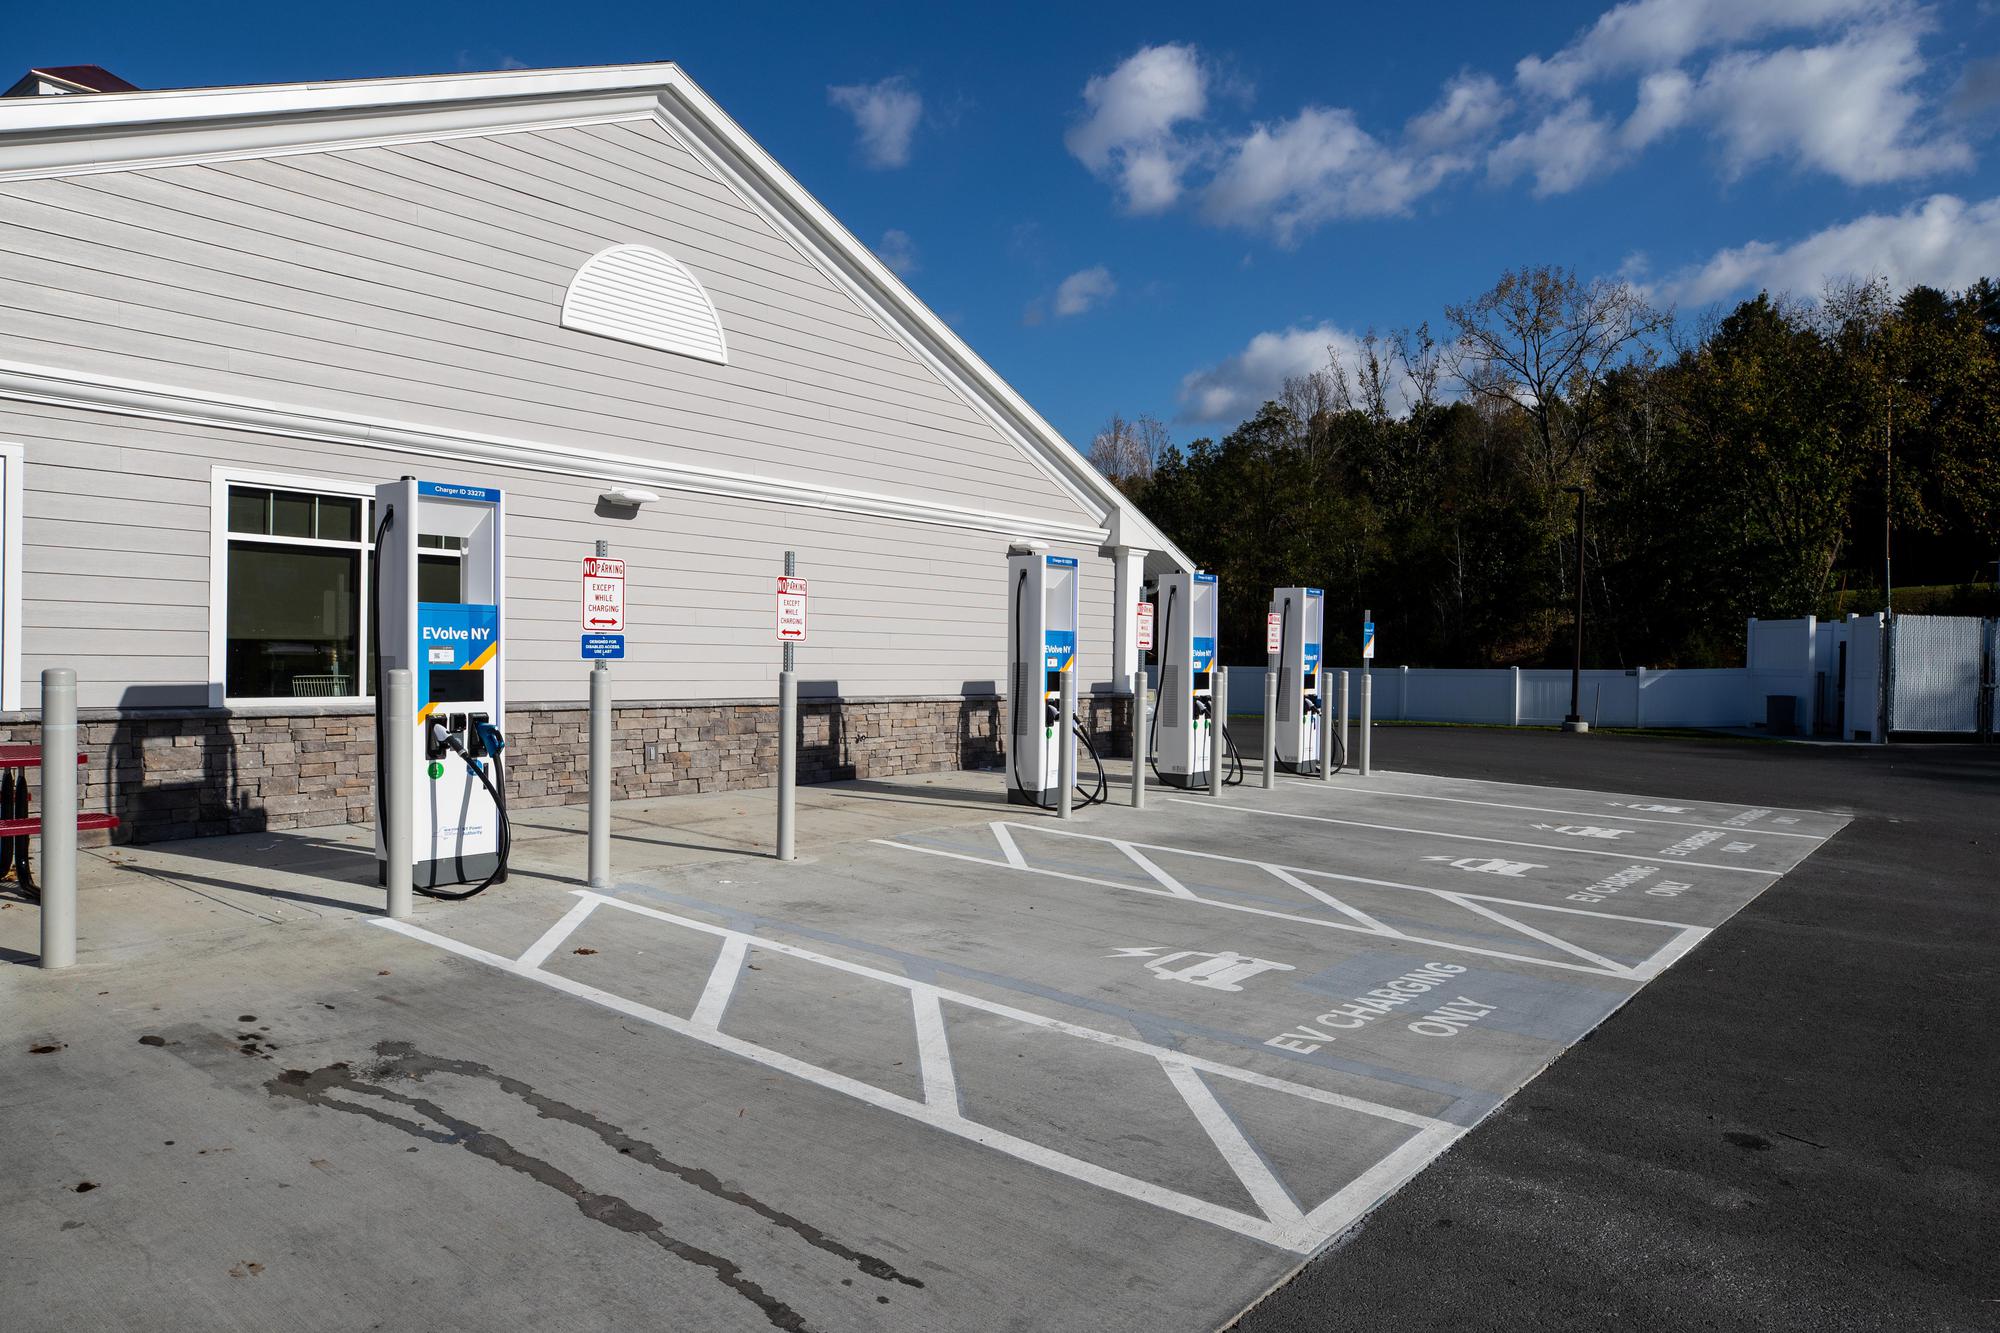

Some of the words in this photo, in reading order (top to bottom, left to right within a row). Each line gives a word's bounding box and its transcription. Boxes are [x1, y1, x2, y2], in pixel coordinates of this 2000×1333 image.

[434, 485, 459, 495] Charger
[584, 560, 596, 576] NO
[596, 563, 623, 575] PARKING
[592, 583, 615, 592] EXCEPT
[777, 579, 787, 592] NO
[787, 582, 806, 592] PARKING
[594, 594, 613, 602] WHILE
[588, 604, 620, 613] CHARGING
[422, 626, 469, 640] EVolve
[471, 627, 490, 640] NY
[1063, 645, 1072, 654] NY
[1263, 1025, 1336, 1055] EV
[1316, 962, 1467, 1029] CHARGING
[1408, 996, 1497, 1037] ONLY
